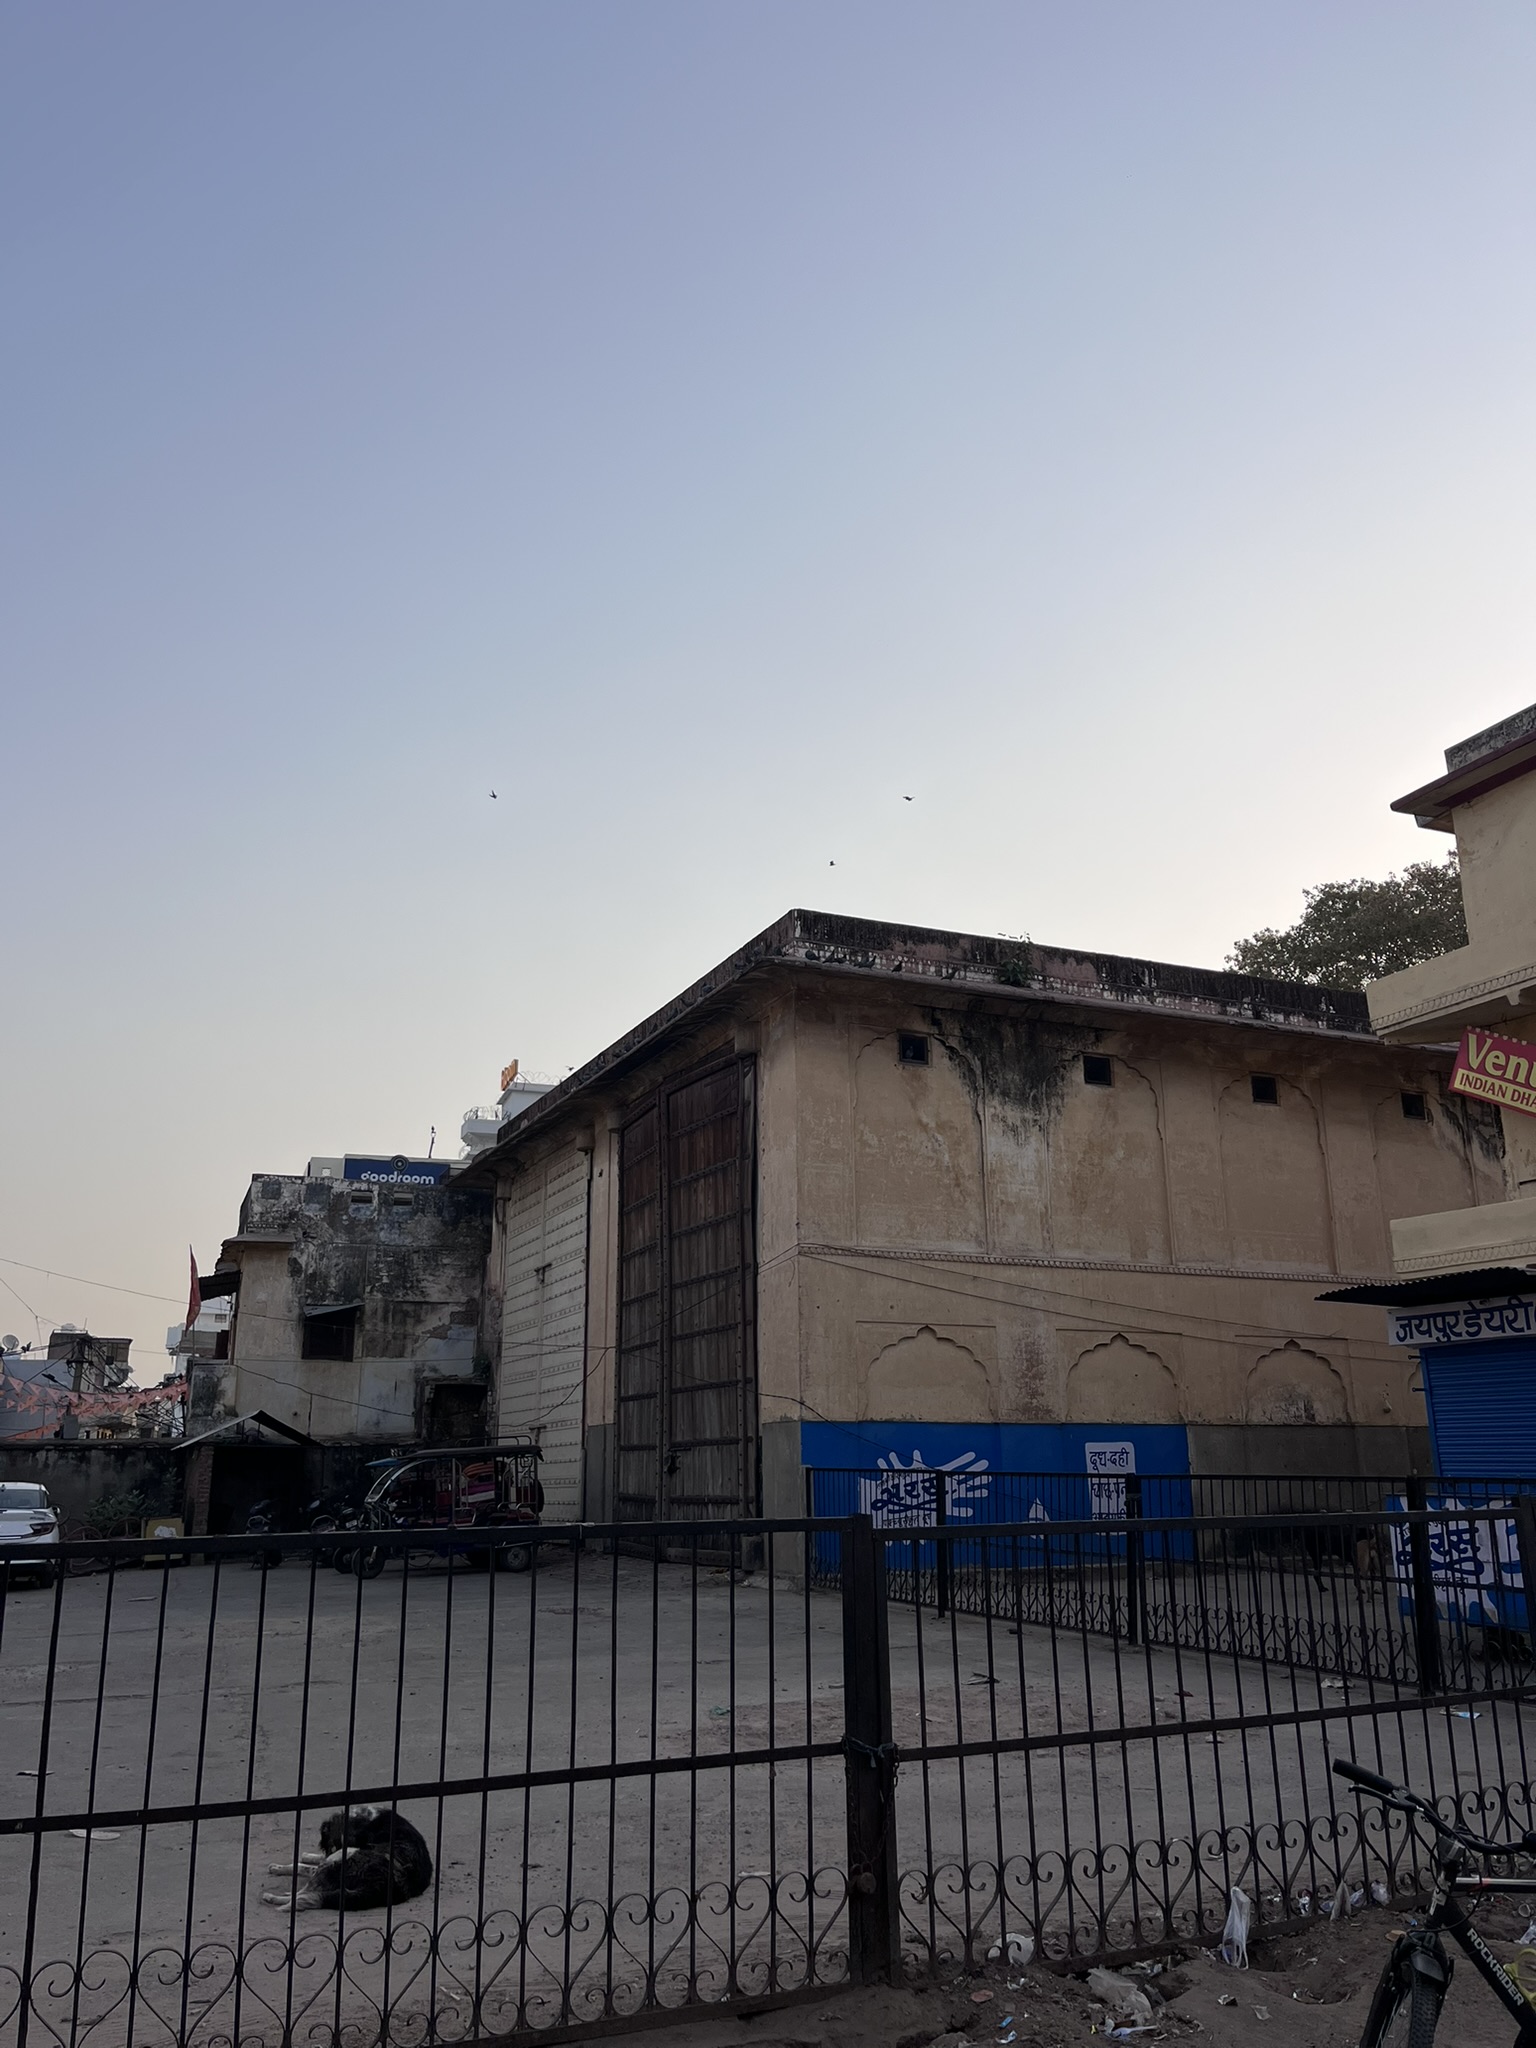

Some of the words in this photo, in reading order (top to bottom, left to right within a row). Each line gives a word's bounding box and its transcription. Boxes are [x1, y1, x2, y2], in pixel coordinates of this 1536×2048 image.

[1459, 1073, 1508, 1099] INDIAN
[360, 1170, 435, 1185] goodroom
[1395, 1311, 1463, 1343] जयपुर
[1463, 1295, 1534, 1338] डेयरी
[1466, 1927, 1526, 2007] ROCKRIDER
